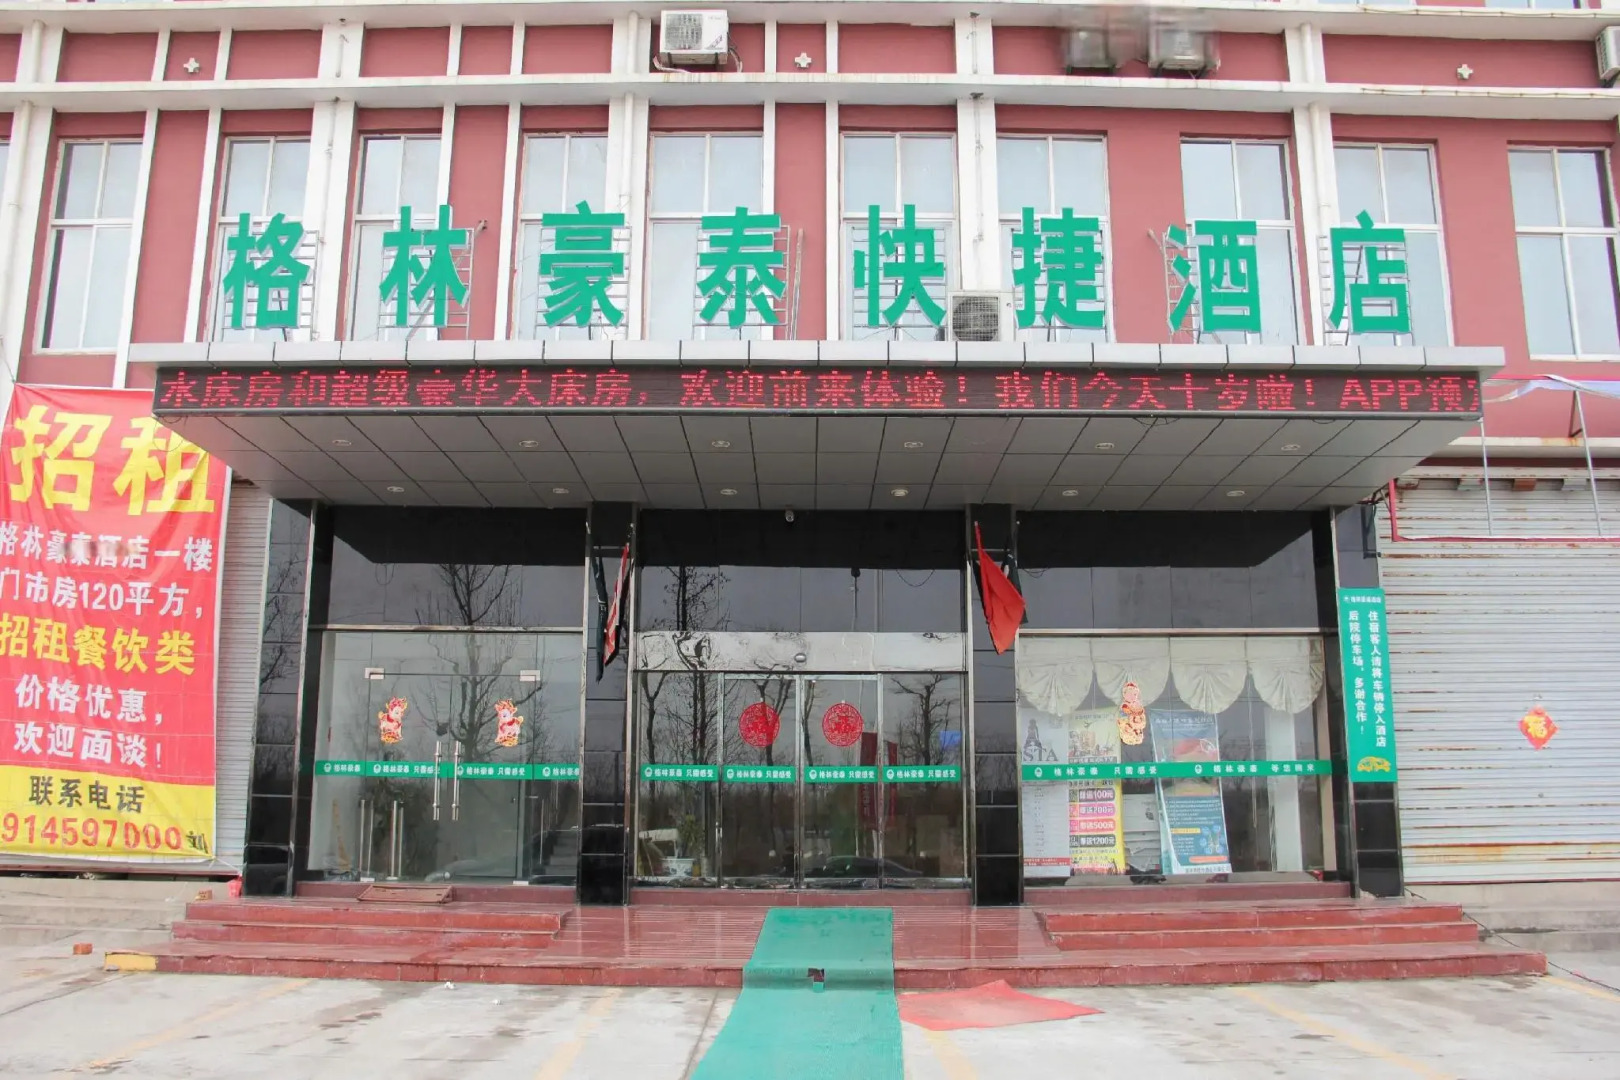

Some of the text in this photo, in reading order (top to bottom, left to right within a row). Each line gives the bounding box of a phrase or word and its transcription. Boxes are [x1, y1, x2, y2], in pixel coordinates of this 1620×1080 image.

[224, 202, 1409, 332] 格林豪泰快捷酒店
[10, 405, 215, 516] 招租
[0, 613, 195, 675] 招租餐饮类
[15, 674, 163, 726] 价格优惠，
[14, 721, 162, 769] 欢迎面谈！
[29, 775, 145, 813] 联系电话
